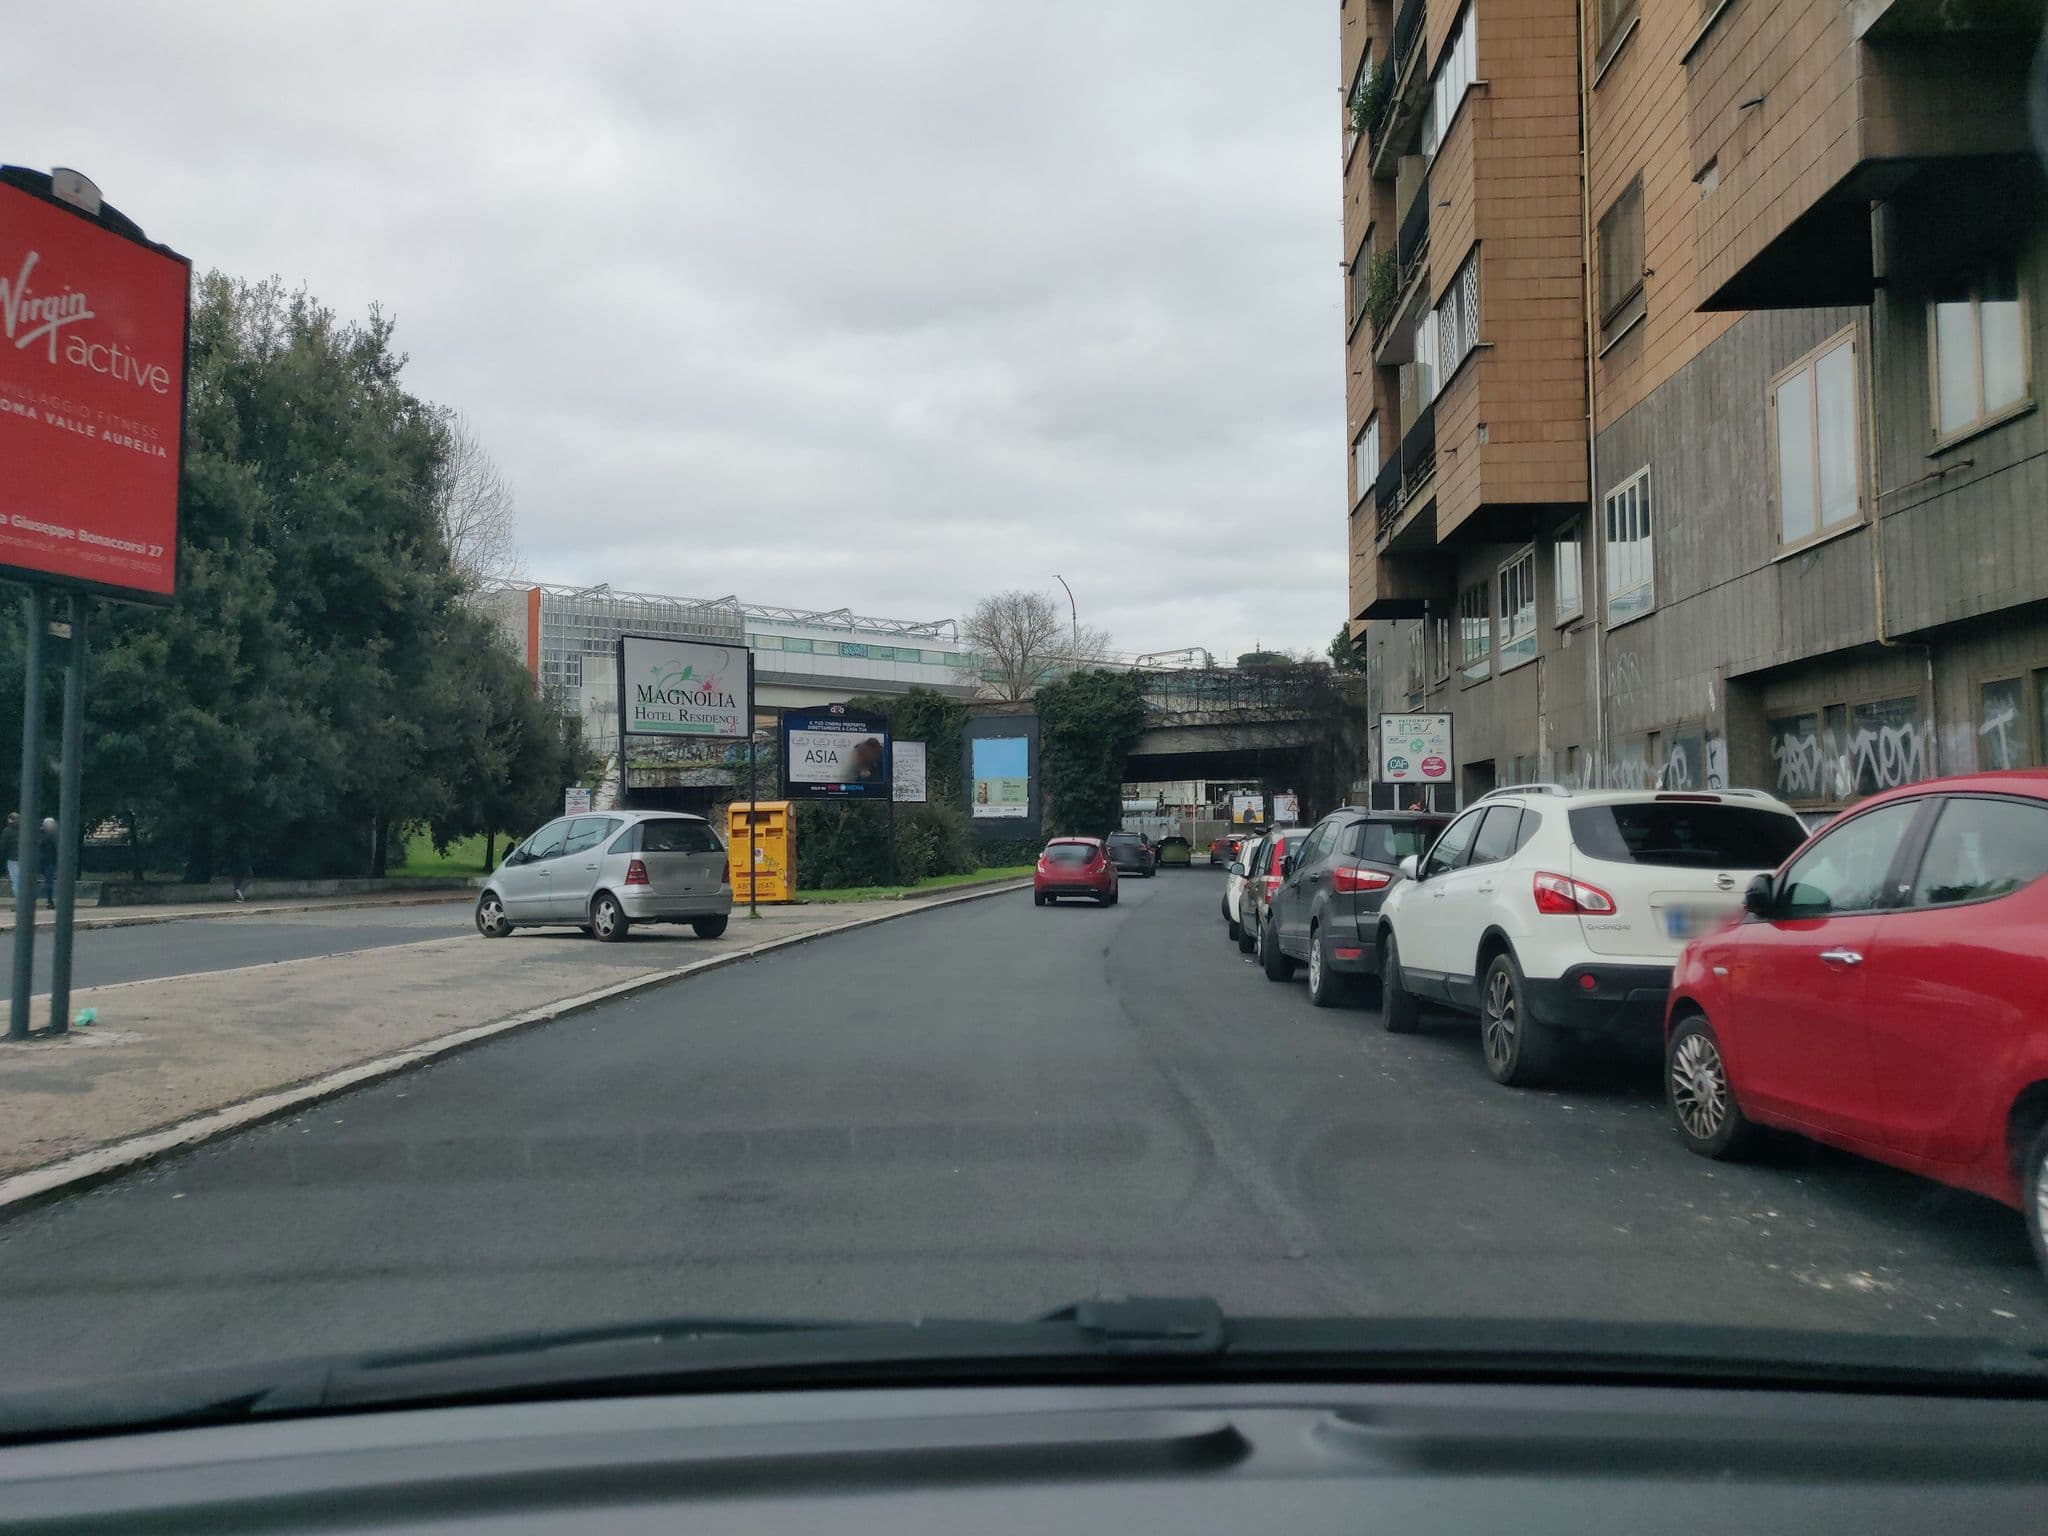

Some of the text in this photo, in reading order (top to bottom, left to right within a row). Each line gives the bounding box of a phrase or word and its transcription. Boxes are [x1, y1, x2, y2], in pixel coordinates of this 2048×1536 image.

[0, 251, 95, 364] Virgin
[66, 335, 169, 394] active
[0, 398, 167, 458] OMA VALLE AURELIA
[11, 513, 75, 539] Giuseppe
[79, 529, 146, 555] Bonaccorsi
[148, 544, 164, 558] 27
[636, 683, 736, 708] MAGNOLIA
[634, 706, 673, 722] HOTEL
[679, 709, 739, 725] RESIDENCE
[804, 749, 839, 764] ASIA
[1390, 759, 1408, 768] CAF
